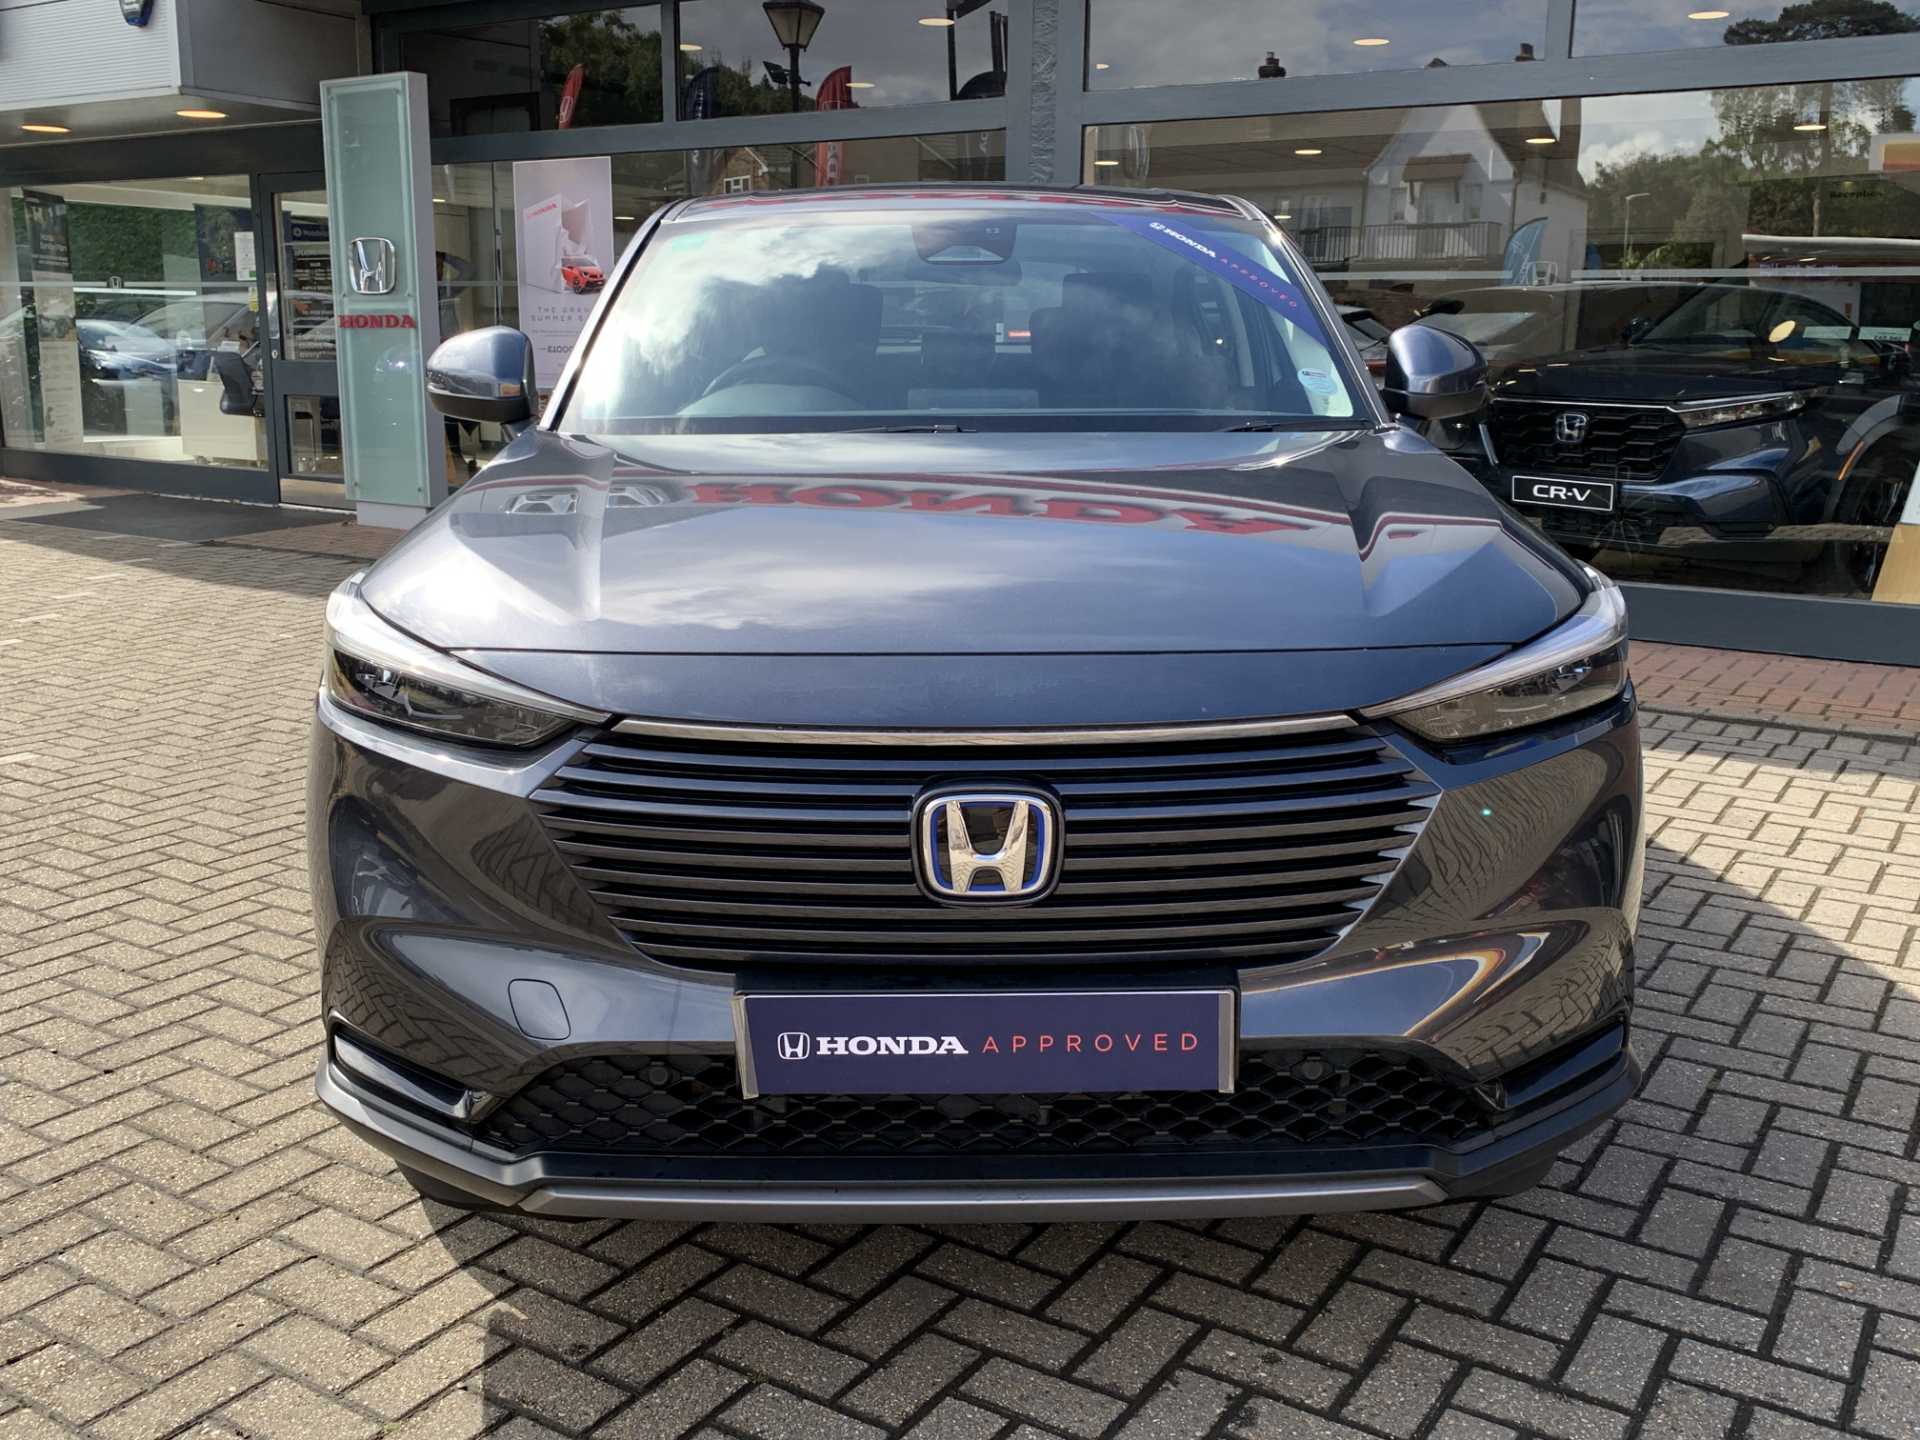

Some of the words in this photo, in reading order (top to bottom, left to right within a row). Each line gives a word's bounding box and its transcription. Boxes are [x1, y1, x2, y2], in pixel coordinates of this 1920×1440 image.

[1164, 228, 1216, 258] HONDA
[1219, 256, 1297, 308] APPROVED
[338, 313, 417, 329] HONDA
[1532, 484, 1591, 502] CR-V
[816, 1035, 969, 1056] HONDA
[982, 1032, 1199, 1054] APPROVED
